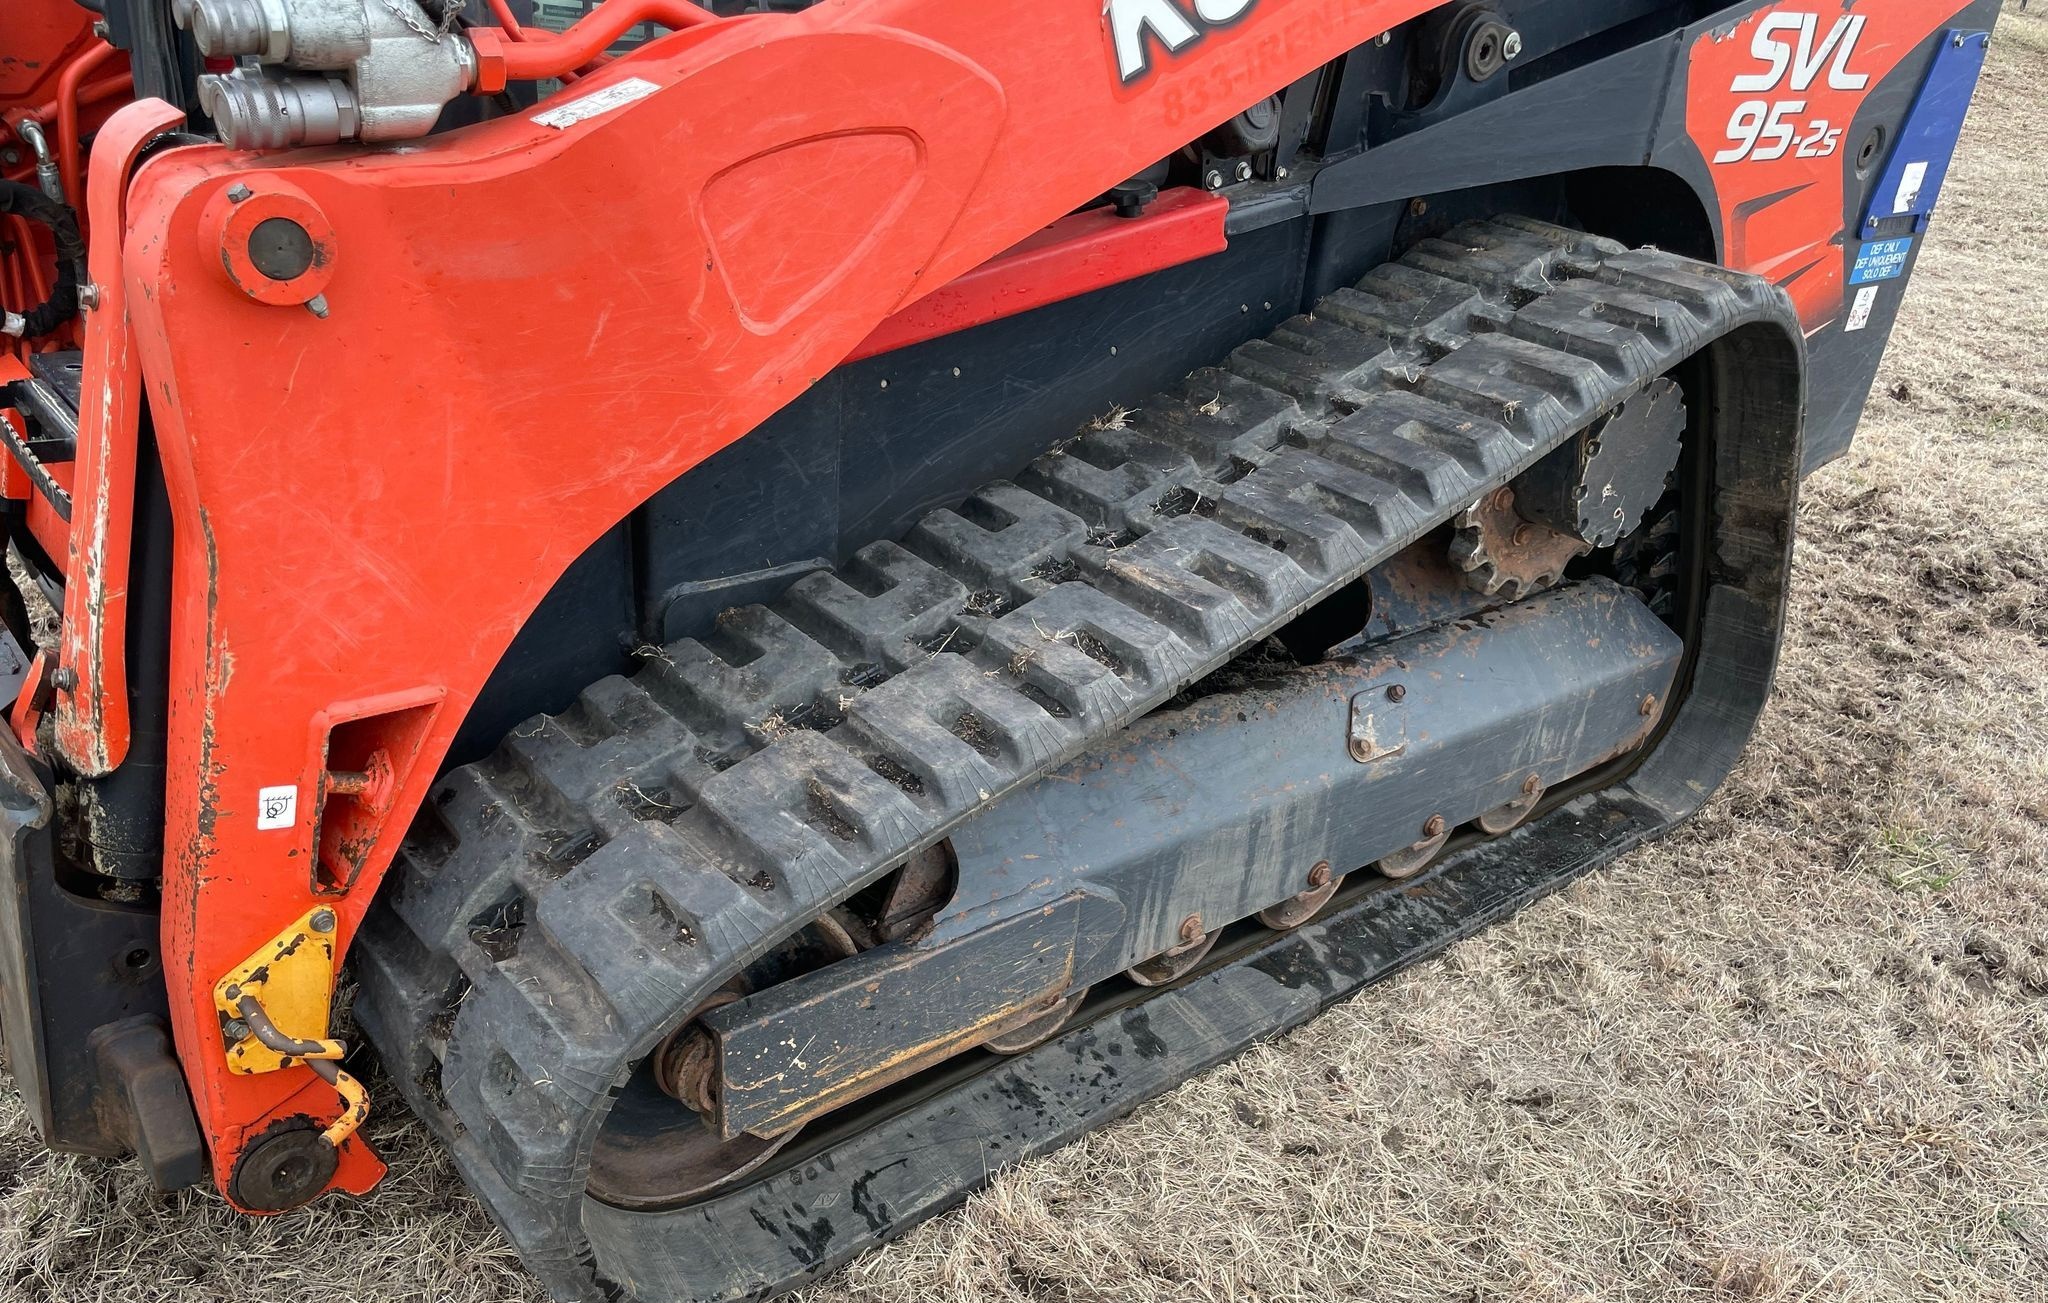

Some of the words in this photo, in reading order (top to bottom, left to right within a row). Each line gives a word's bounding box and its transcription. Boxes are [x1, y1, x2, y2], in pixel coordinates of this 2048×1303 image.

[1730, 12, 1869, 92] SVL
[1870, 243, 1884, 255] DEF
[1855, 257, 1869, 269] DEF
[1862, 268, 1879, 280] SOLO
[1878, 265, 1892, 277] DEF
